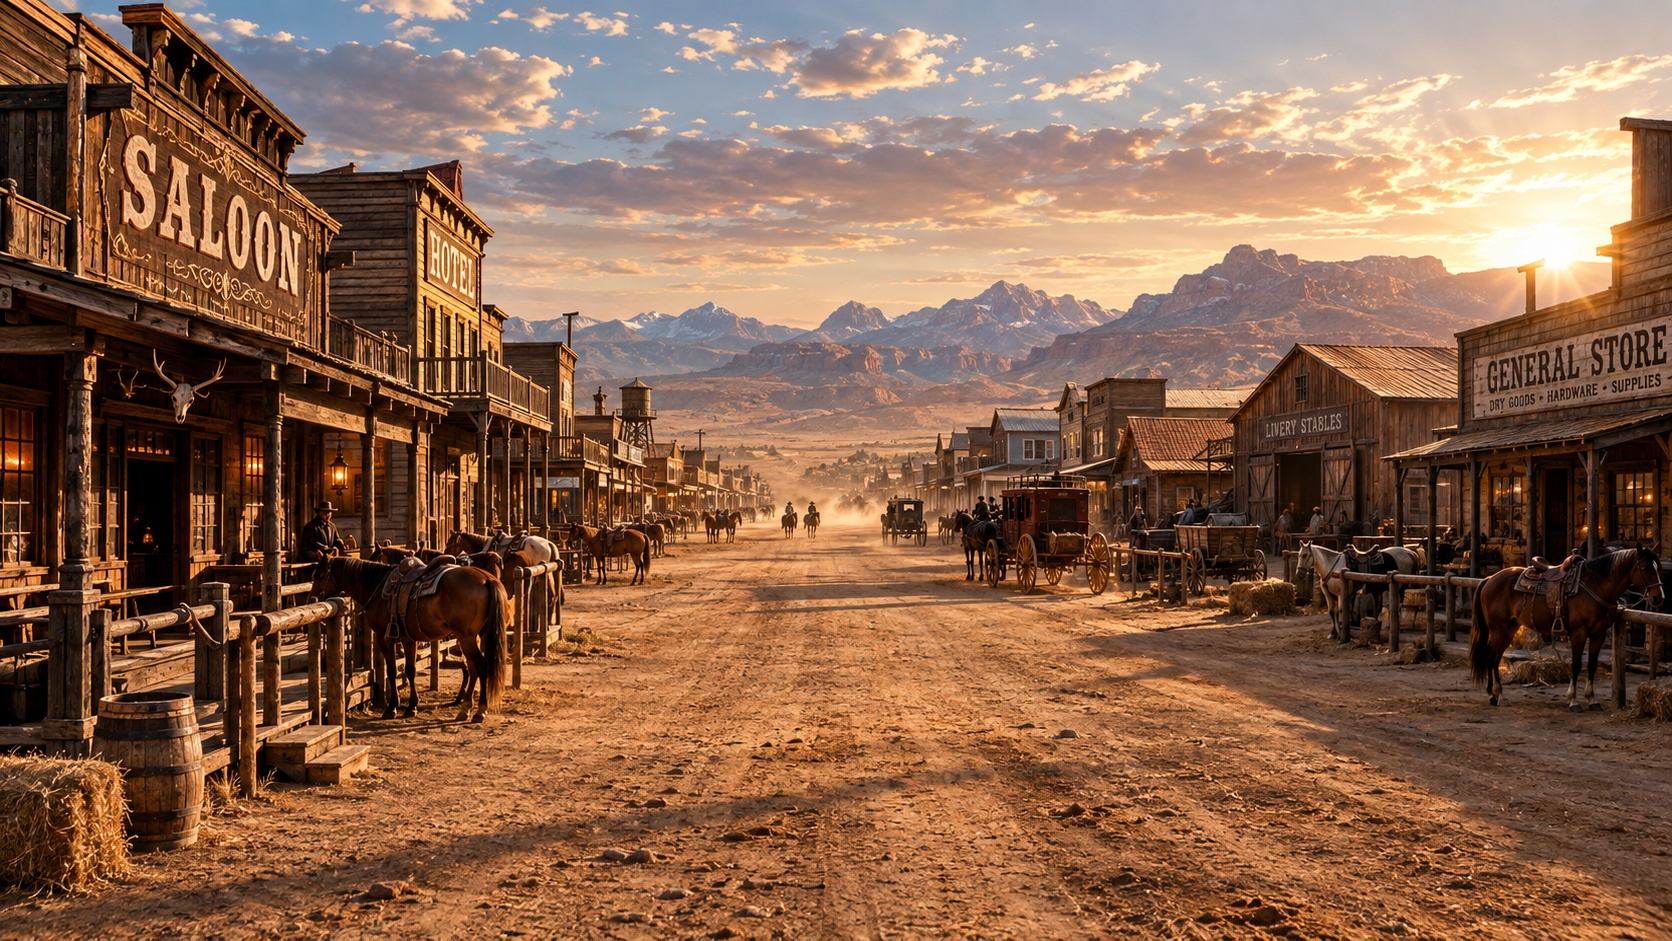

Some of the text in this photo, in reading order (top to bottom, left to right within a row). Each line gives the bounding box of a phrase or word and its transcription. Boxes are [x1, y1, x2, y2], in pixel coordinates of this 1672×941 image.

[120, 134, 302, 297] SALOON
[429, 229, 475, 300] HOTEL
[1487, 325, 1667, 394] GENERAL STORE
[1489, 372, 1662, 412] DRY GOODS HARDWARE SUPPLIES
[1265, 413, 1342, 438] LIVERY STABLES
